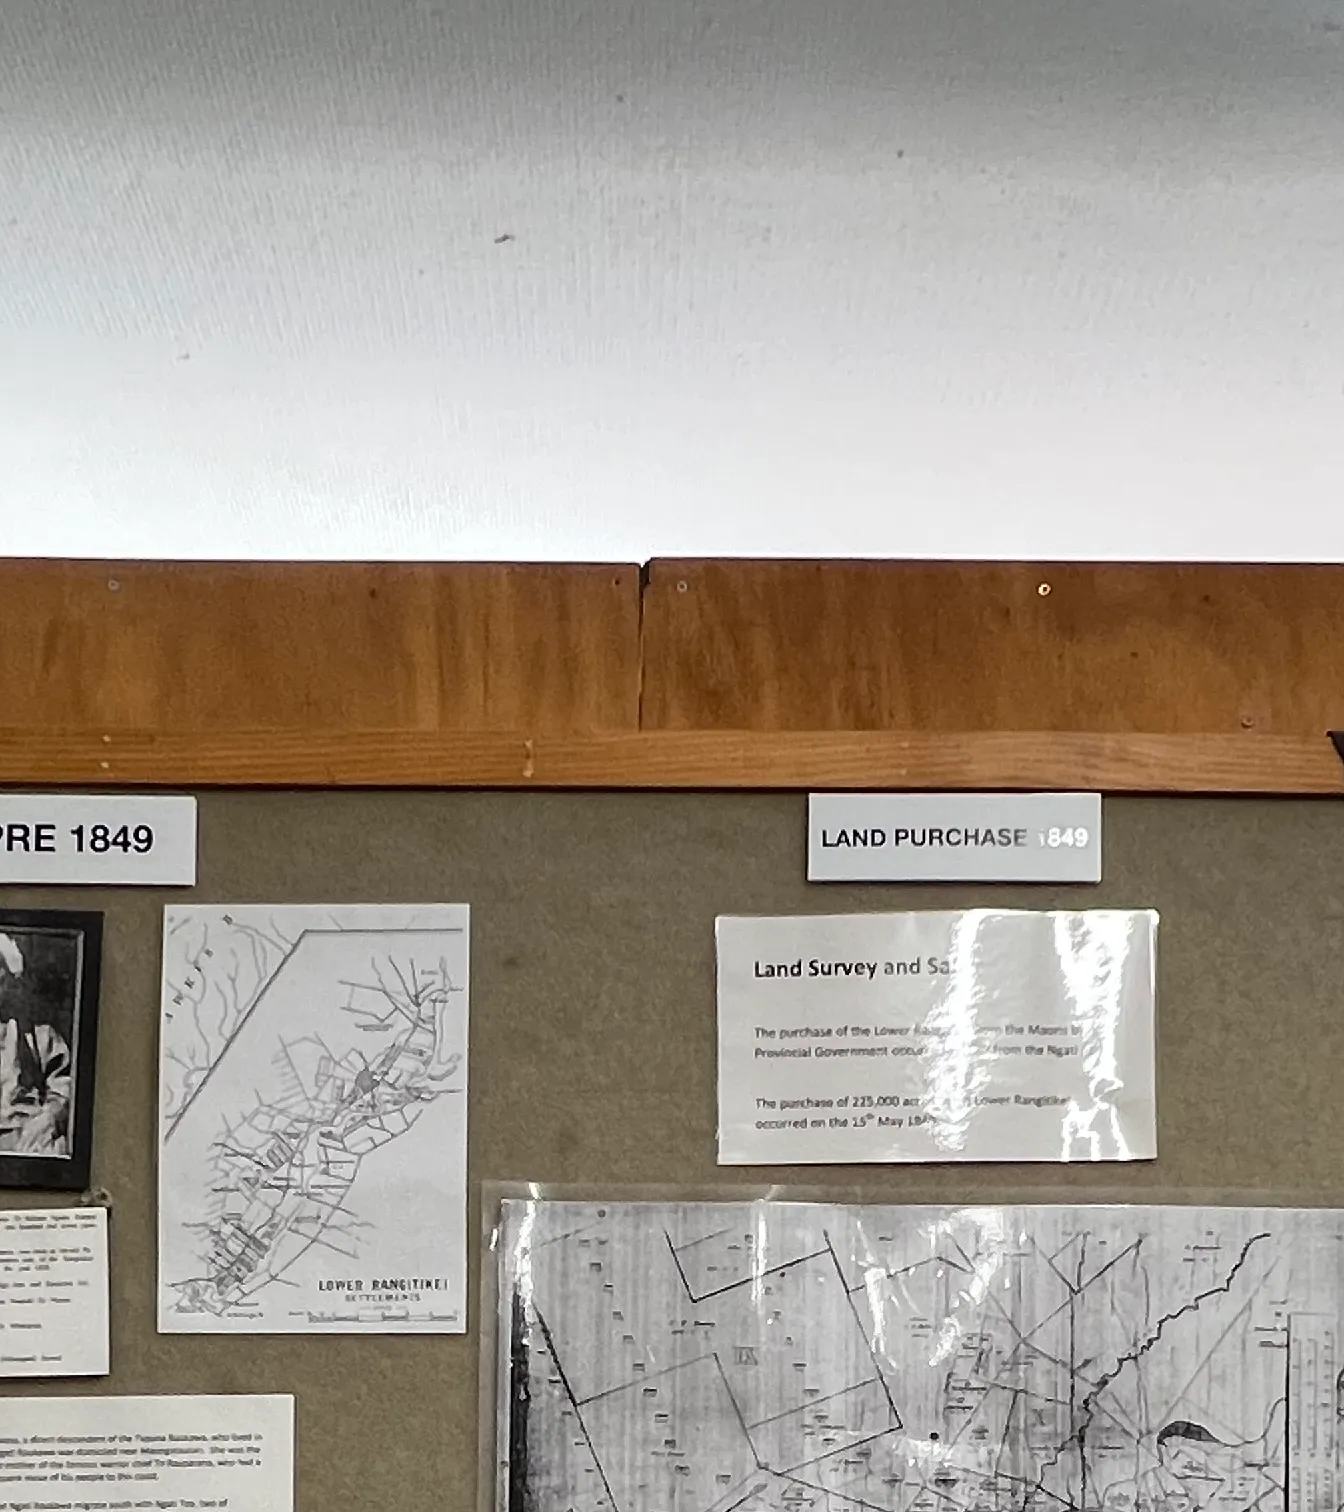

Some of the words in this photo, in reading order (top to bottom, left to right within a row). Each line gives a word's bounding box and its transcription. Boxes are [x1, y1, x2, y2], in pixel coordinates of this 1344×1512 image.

[70, 824, 155, 853] 1849
[821, 828, 886, 848] LAND
[894, 827, 1027, 848] PURCHASE
[754, 958, 802, 978] Land
[808, 957, 878, 980] Survey
[884, 956, 921, 976] and
[755, 1027, 776, 1039] The
[779, 1026, 833, 1040] purchase
[835, 1025, 848, 1037] of
[851, 1026, 871, 1037] the
[874, 1026, 909, 1036] Lower
[755, 1047, 812, 1059] Provincial
[815, 1046, 888, 1058] Government
[756, 1098, 776, 1110] The
[779, 1097, 834, 1111] purchase
[836, 1095, 849, 1108] of
[755, 1117, 807, 1129] occurred
[810, 1120, 825, 1128] on
[828, 1117, 848, 1128] the
[877, 1116, 904, 1129] May
[318, 1279, 364, 1291] LOWER
